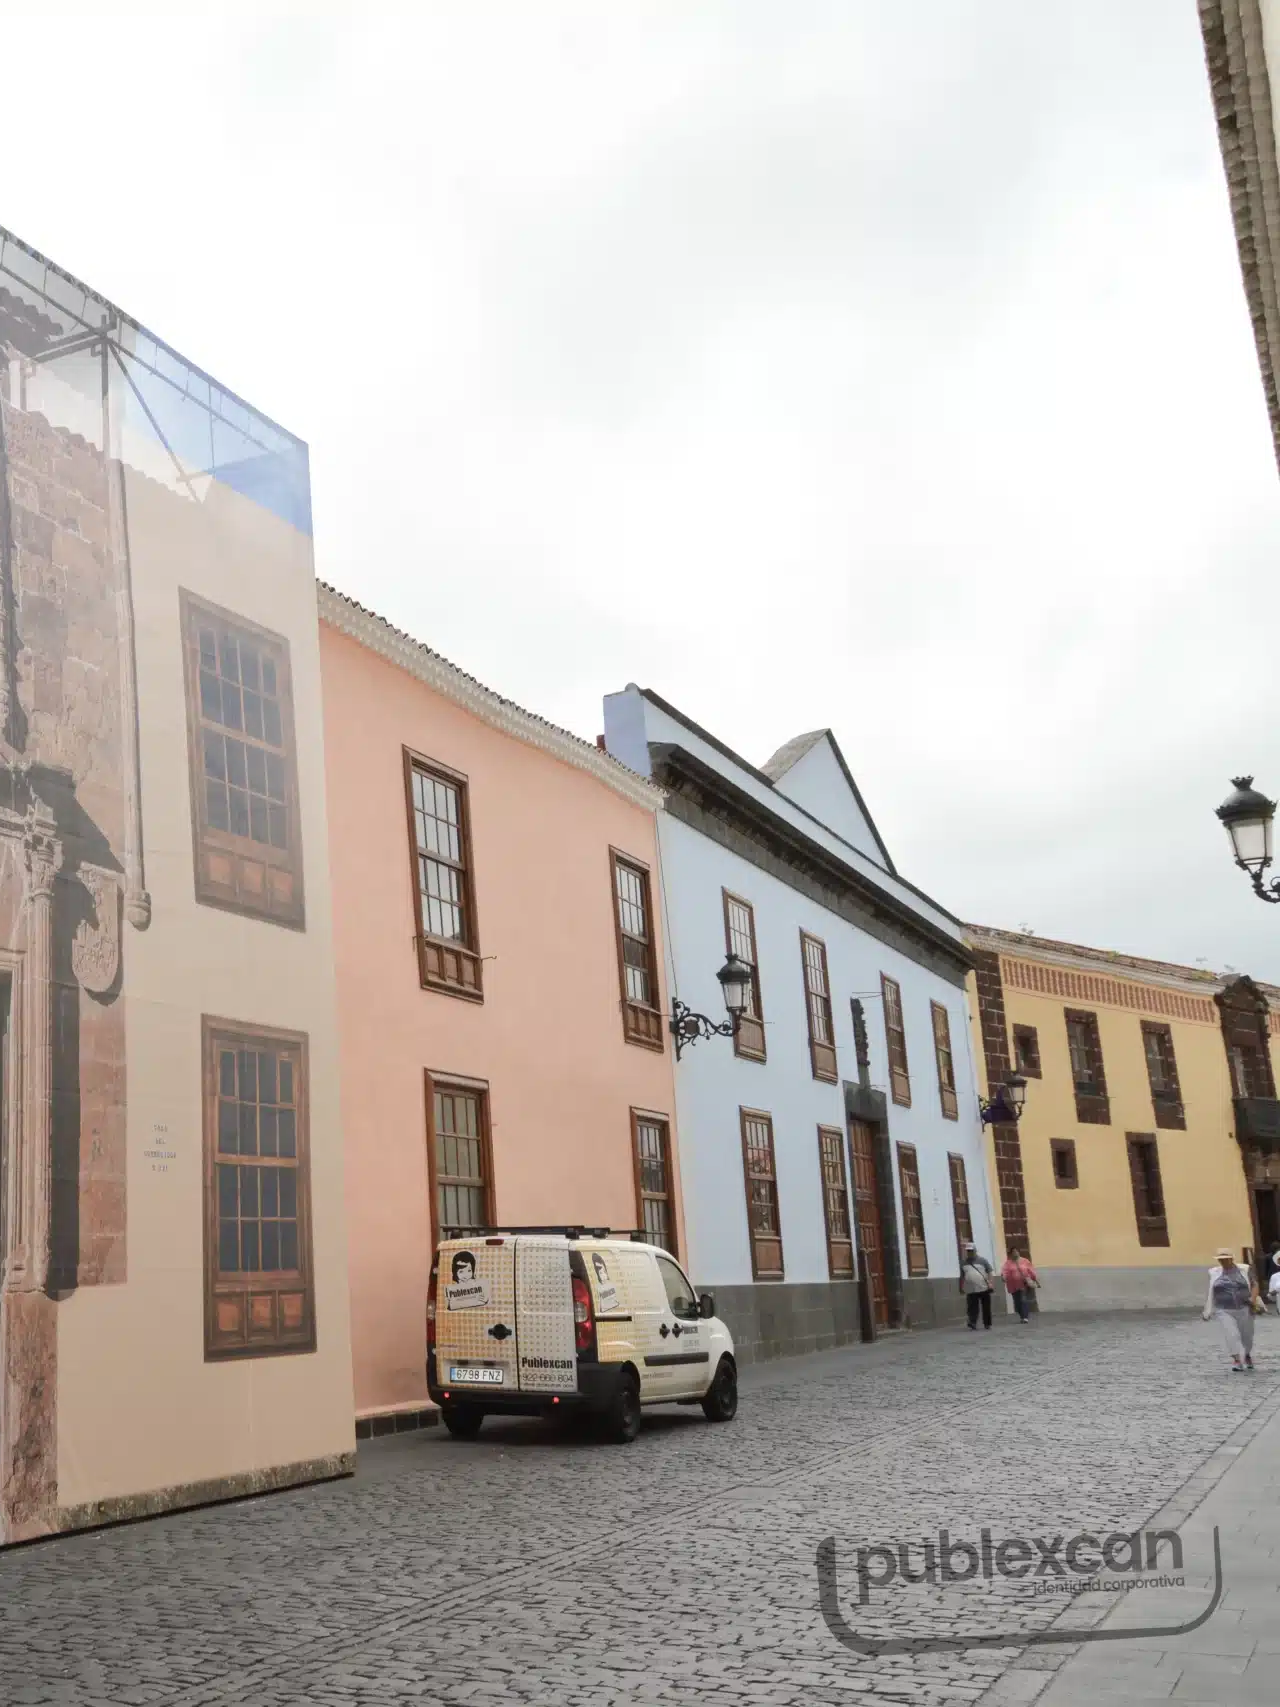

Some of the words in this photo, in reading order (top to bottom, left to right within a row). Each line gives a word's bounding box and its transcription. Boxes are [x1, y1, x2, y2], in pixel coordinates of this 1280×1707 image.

[449, 1286, 482, 1298] Publexcan
[522, 1357, 573, 1369] Publexcan
[456, 1370, 480, 1380] 6798
[482, 1371, 501, 1380] FNZ
